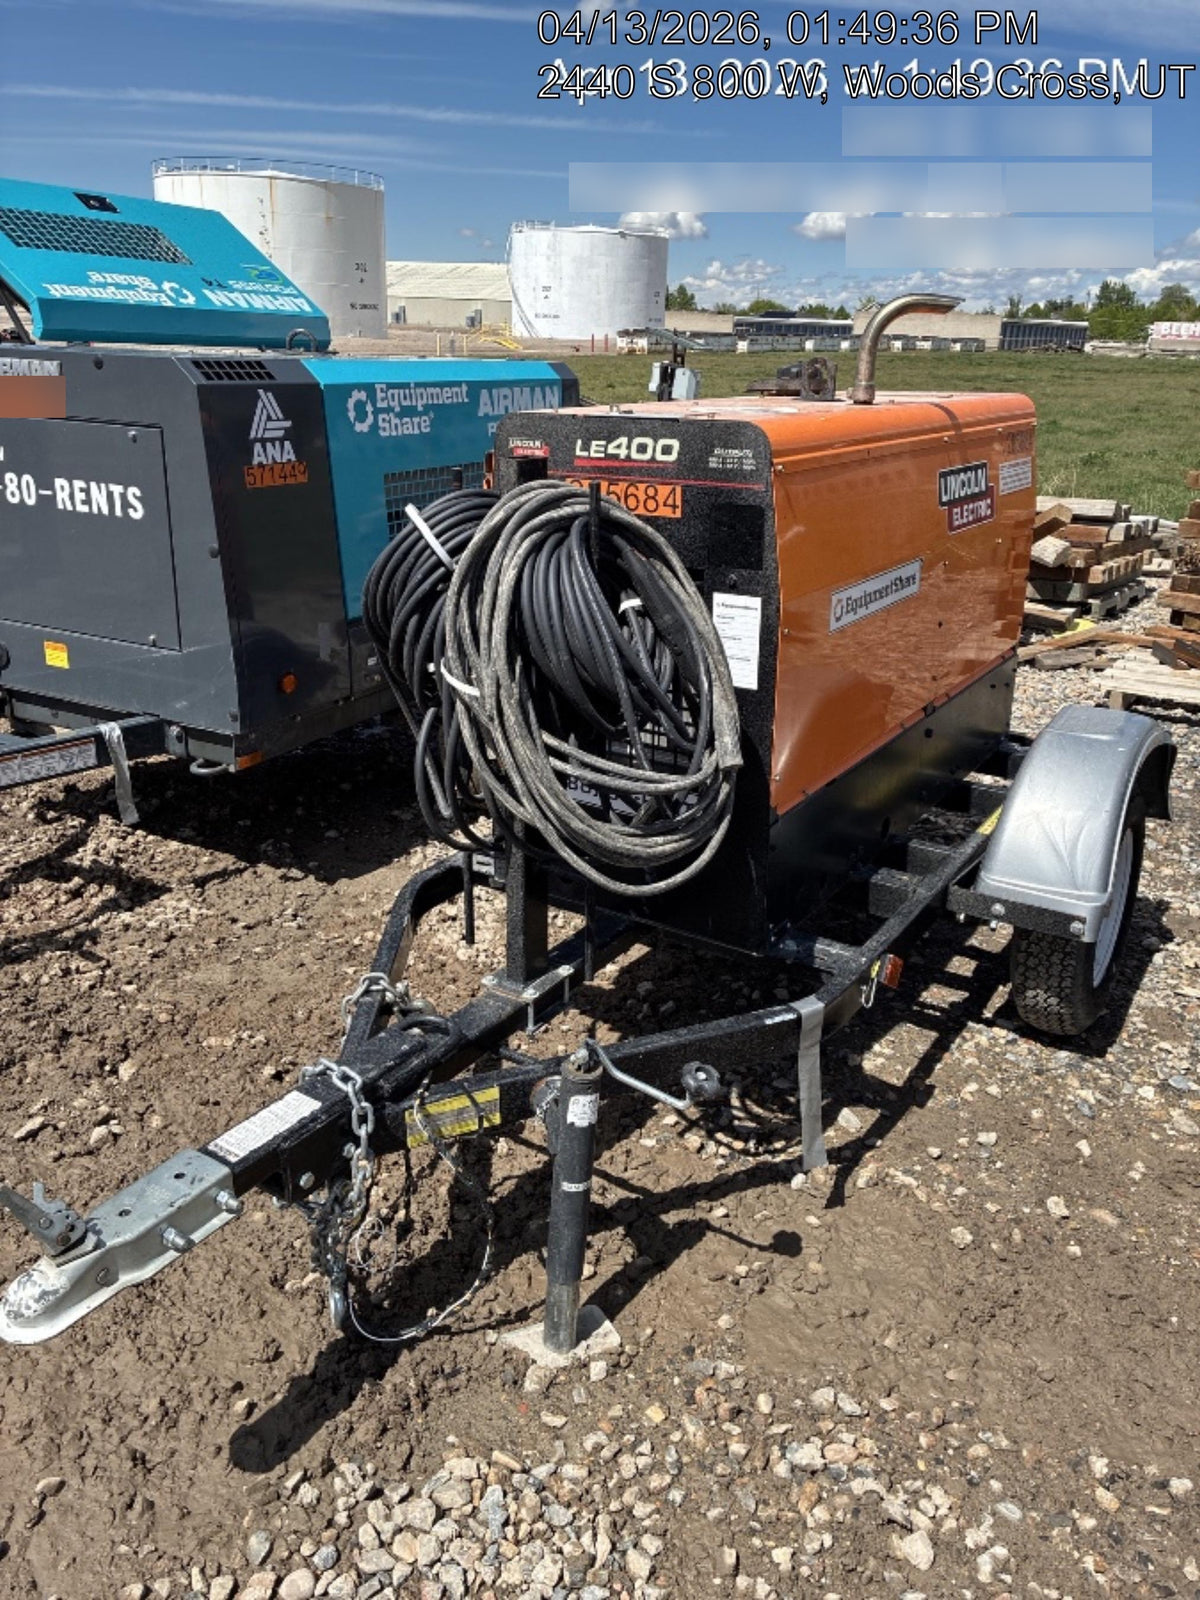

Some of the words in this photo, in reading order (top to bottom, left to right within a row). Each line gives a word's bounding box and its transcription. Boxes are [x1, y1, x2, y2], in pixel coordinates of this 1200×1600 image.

[202, 289, 313, 313] AIRMAN
[375, 382, 469, 412] Equipment
[478, 386, 561, 417] AIRMAN
[378, 412, 431, 437] Share
[252, 440, 297, 465] ANA
[575, 436, 680, 462] LE400
[0, 471, 145, 520] 80-RENTS
[570, 479, 680, 514] 5684
[940, 467, 986, 502] LINCOLN
[952, 498, 992, 527] ELECTRIC
[846, 572, 917, 616] EquipmentShare
